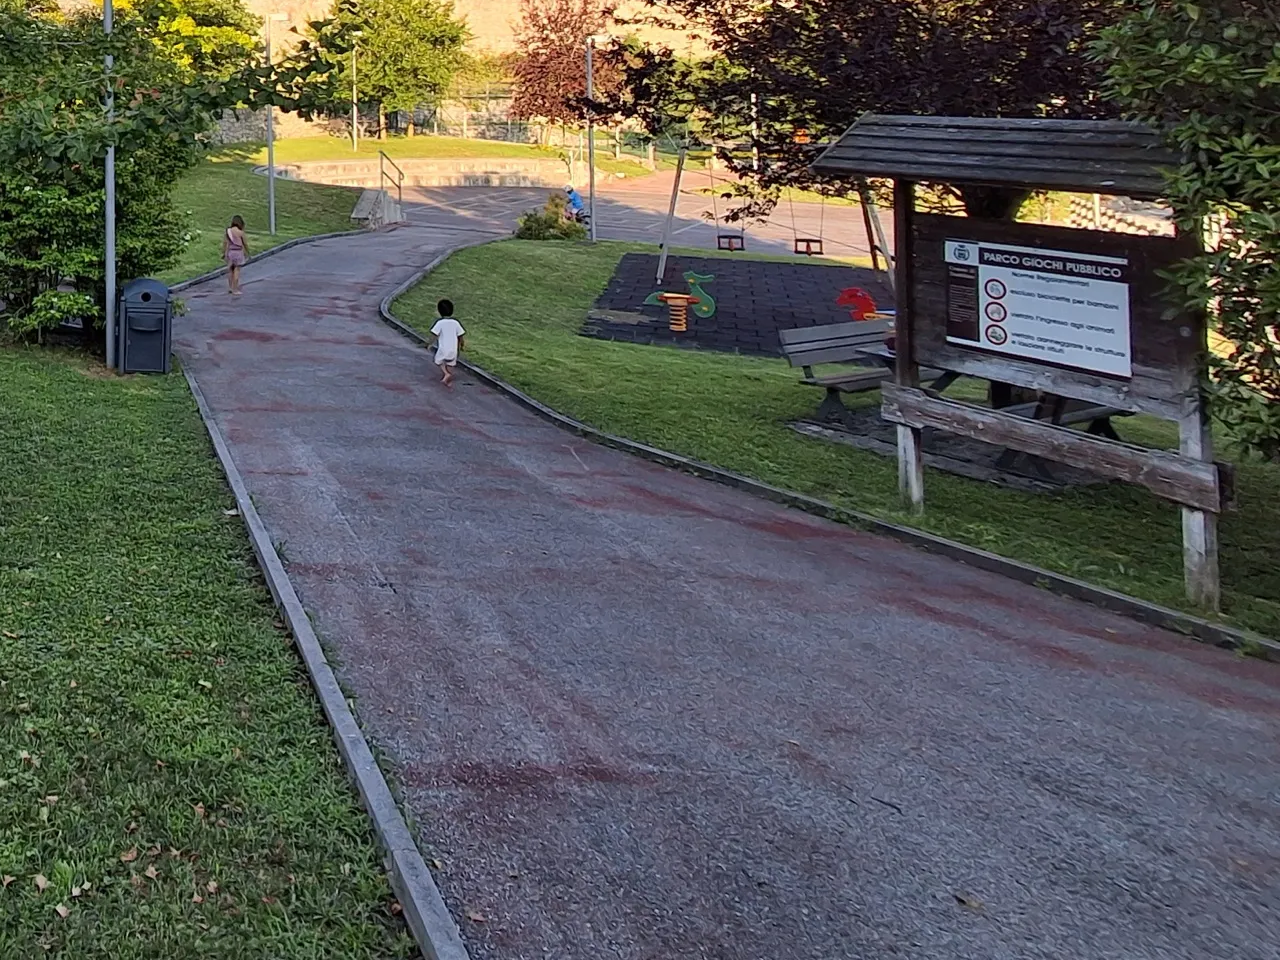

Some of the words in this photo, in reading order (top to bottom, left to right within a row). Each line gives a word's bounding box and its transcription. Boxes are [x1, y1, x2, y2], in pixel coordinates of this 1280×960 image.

[983, 252, 1020, 265] PARCO
[1022, 256, 1063, 271] GIOCHI
[1066, 262, 1122, 278] PUBBLICO
[1011, 271, 1035, 280] Norme
[1036, 274, 1090, 287] Regolamentari
[1010, 289, 1036, 297] escluso
[1086, 300, 1119, 310] bambini
[1070, 321, 1084, 330] agli
[1085, 324, 1115, 334] animali
